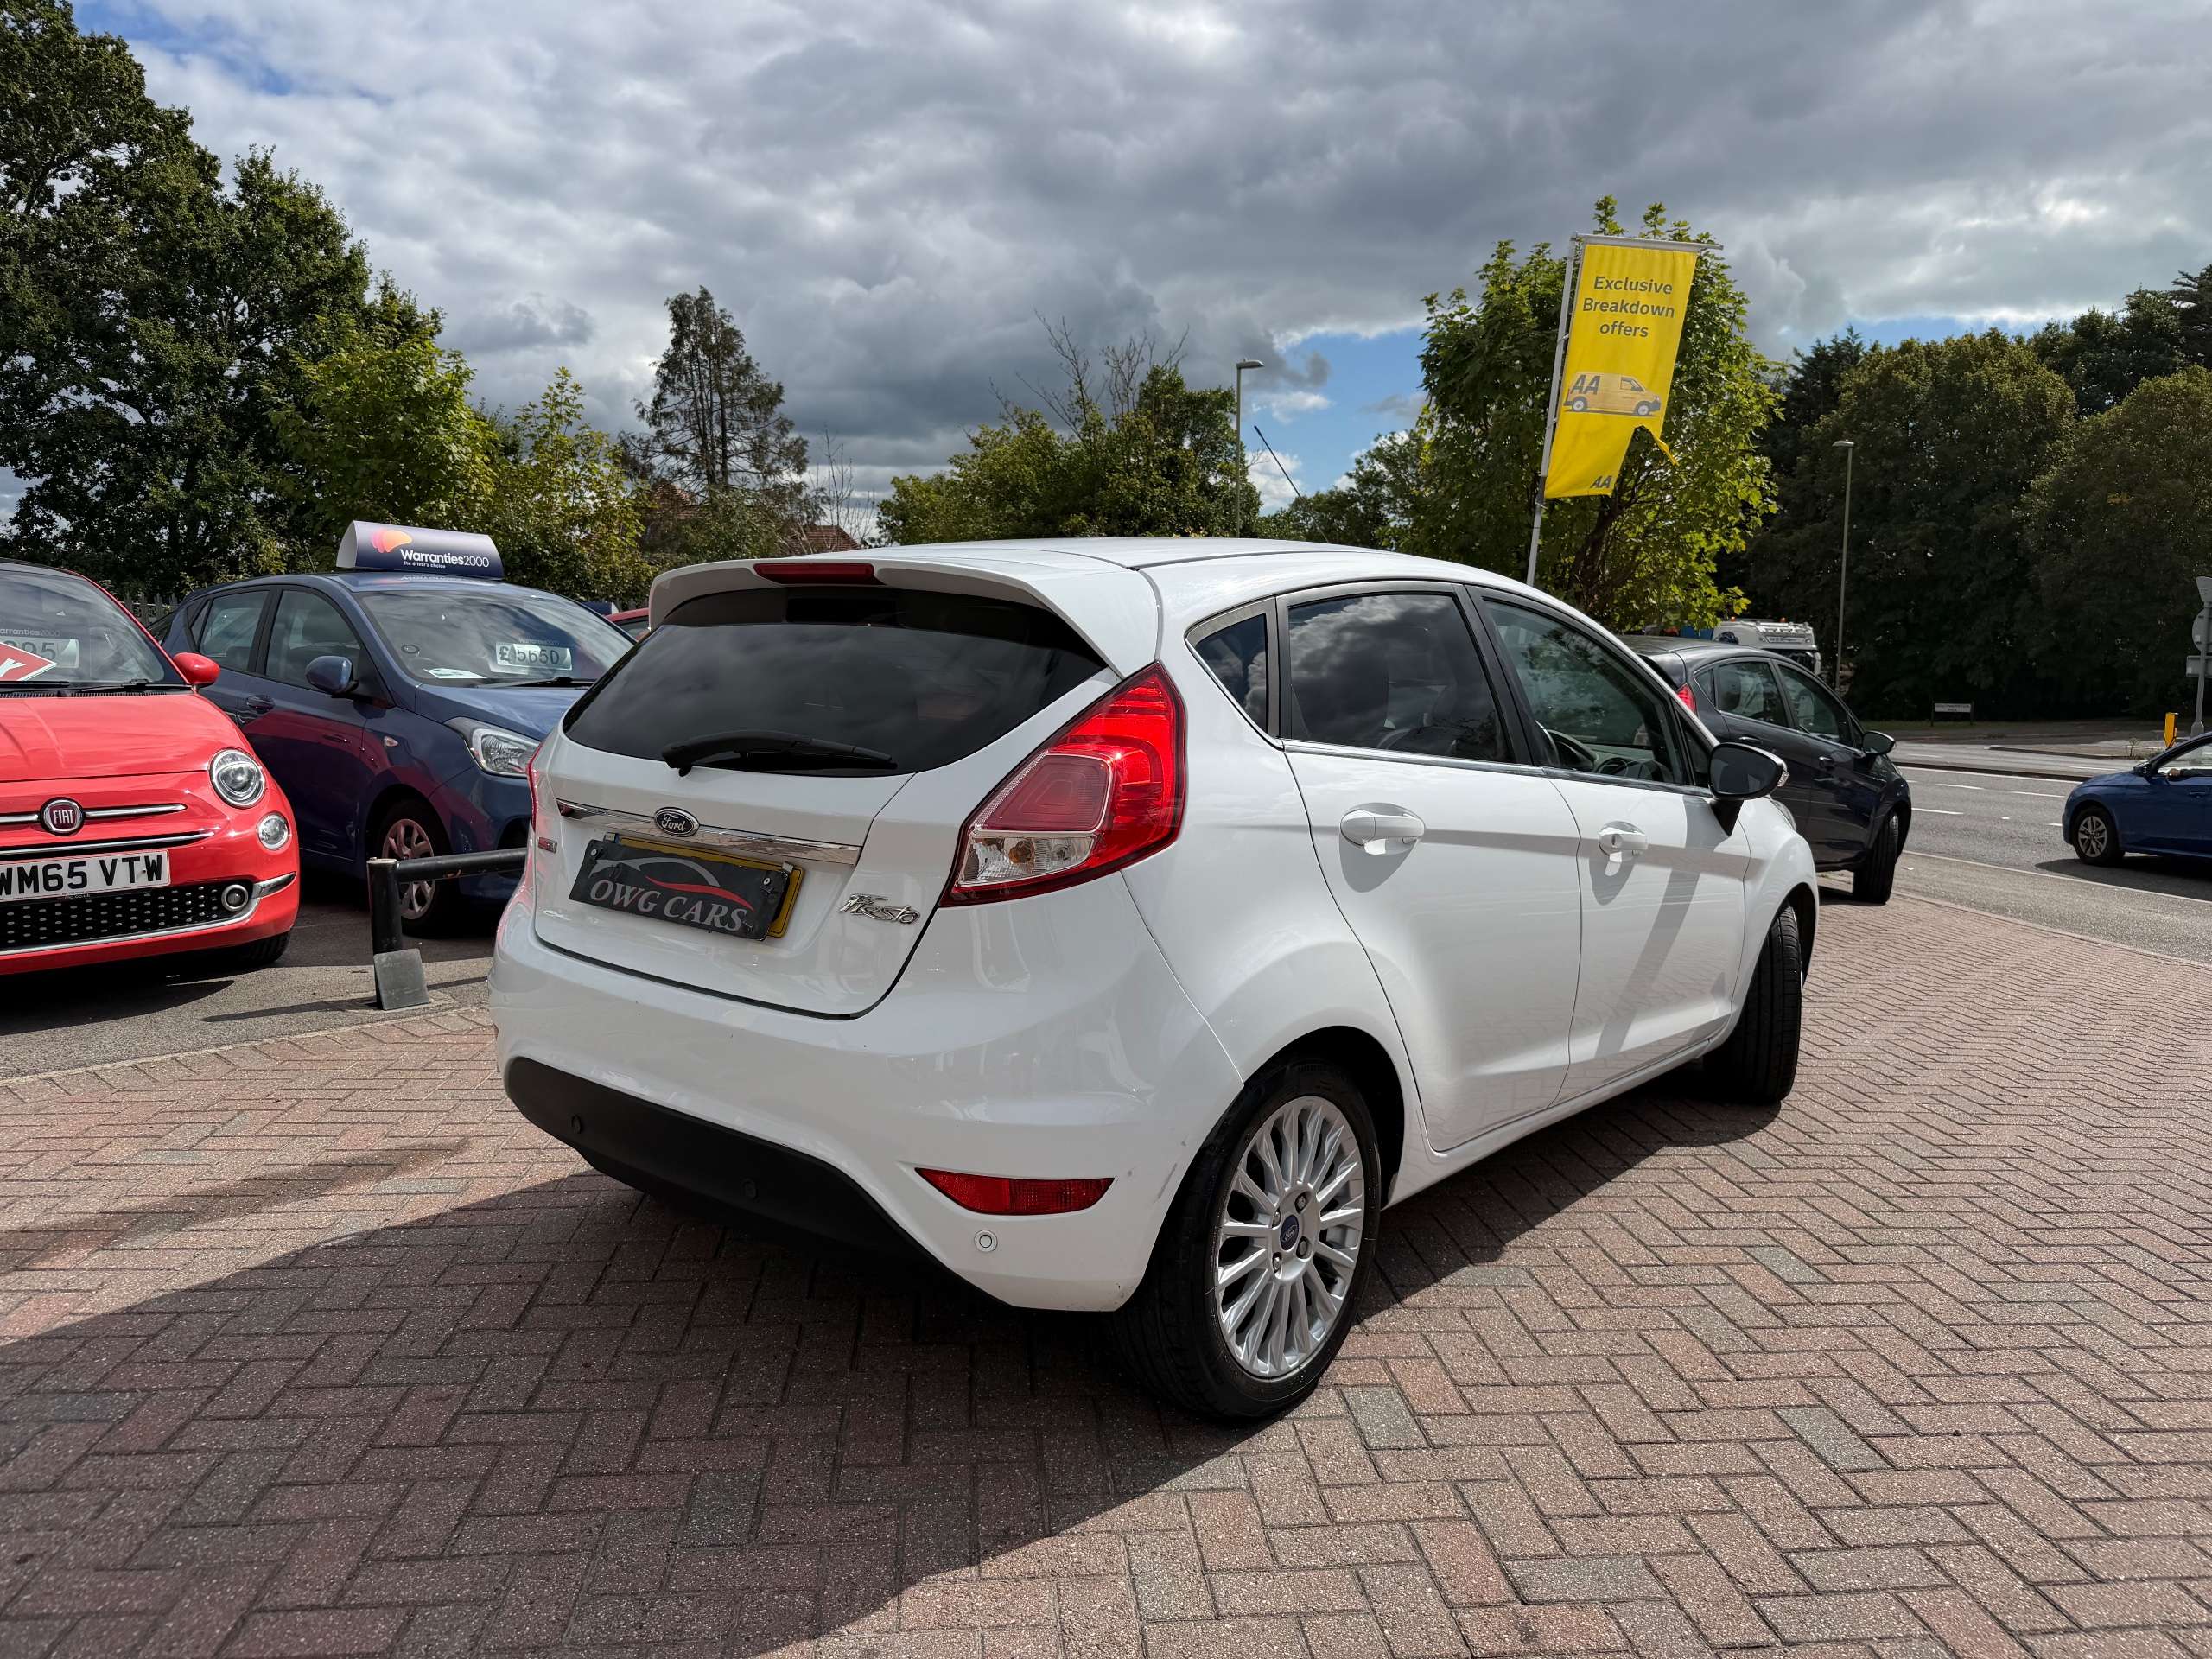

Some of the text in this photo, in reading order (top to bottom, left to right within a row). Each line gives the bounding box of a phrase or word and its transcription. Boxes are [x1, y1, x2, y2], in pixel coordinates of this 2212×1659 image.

[1593, 276, 1673, 295] Exclusive
[1583, 297, 1675, 318] Breakdown
[1599, 321, 1649, 338] offers
[1570, 373, 1601, 395] AA
[1589, 475, 1612, 489] AA
[399, 548, 490, 568] Warranties2000
[53, 809, 74, 824] FIAT
[663, 813, 687, 831] Ford
[99, 854, 162, 887] VTW
[590, 879, 748, 931] OWG CARS
